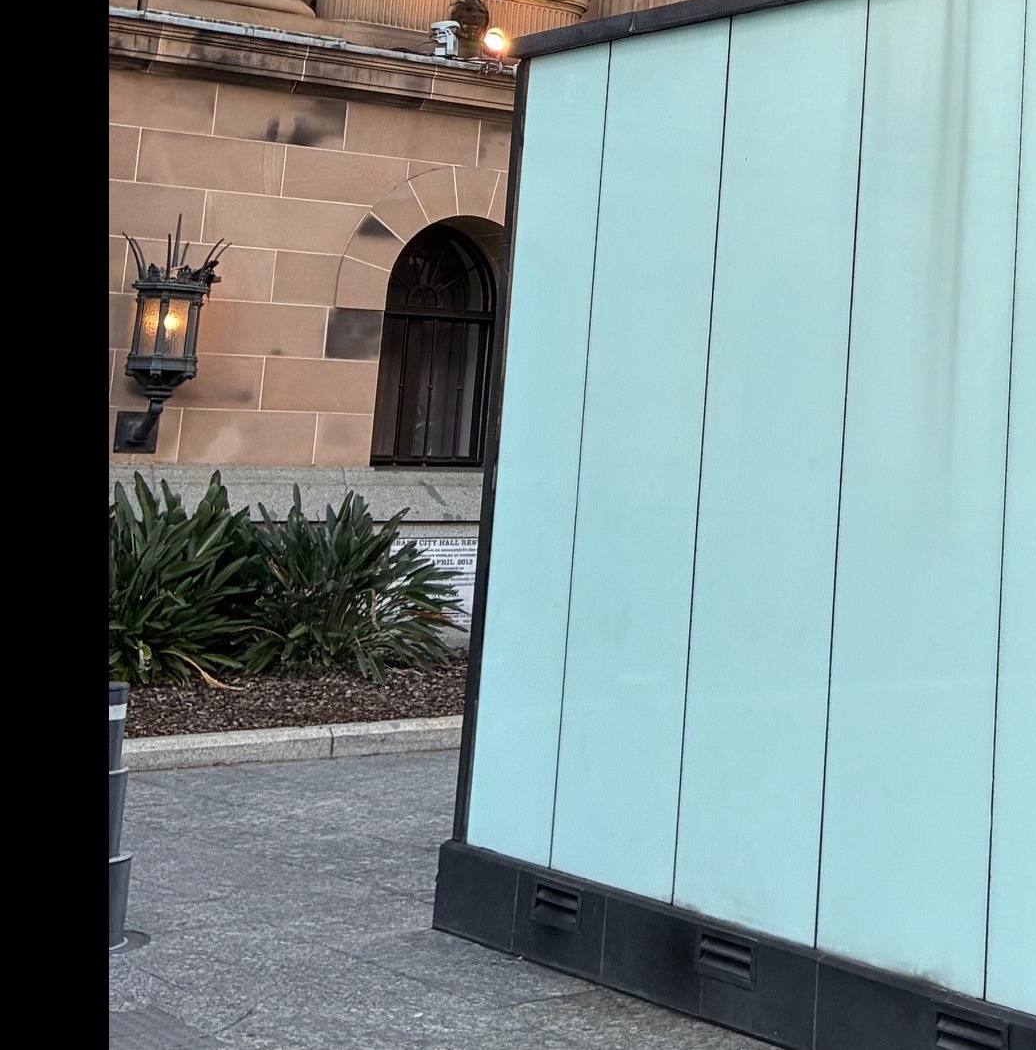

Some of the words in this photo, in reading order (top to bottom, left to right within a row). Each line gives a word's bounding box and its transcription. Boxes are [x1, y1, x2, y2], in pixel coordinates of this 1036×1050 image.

[419, 539, 438, 547] CITY
[439, 539, 461, 547] HALL
[432, 558, 455, 566] APRIL
[457, 558, 473, 566] 2013
